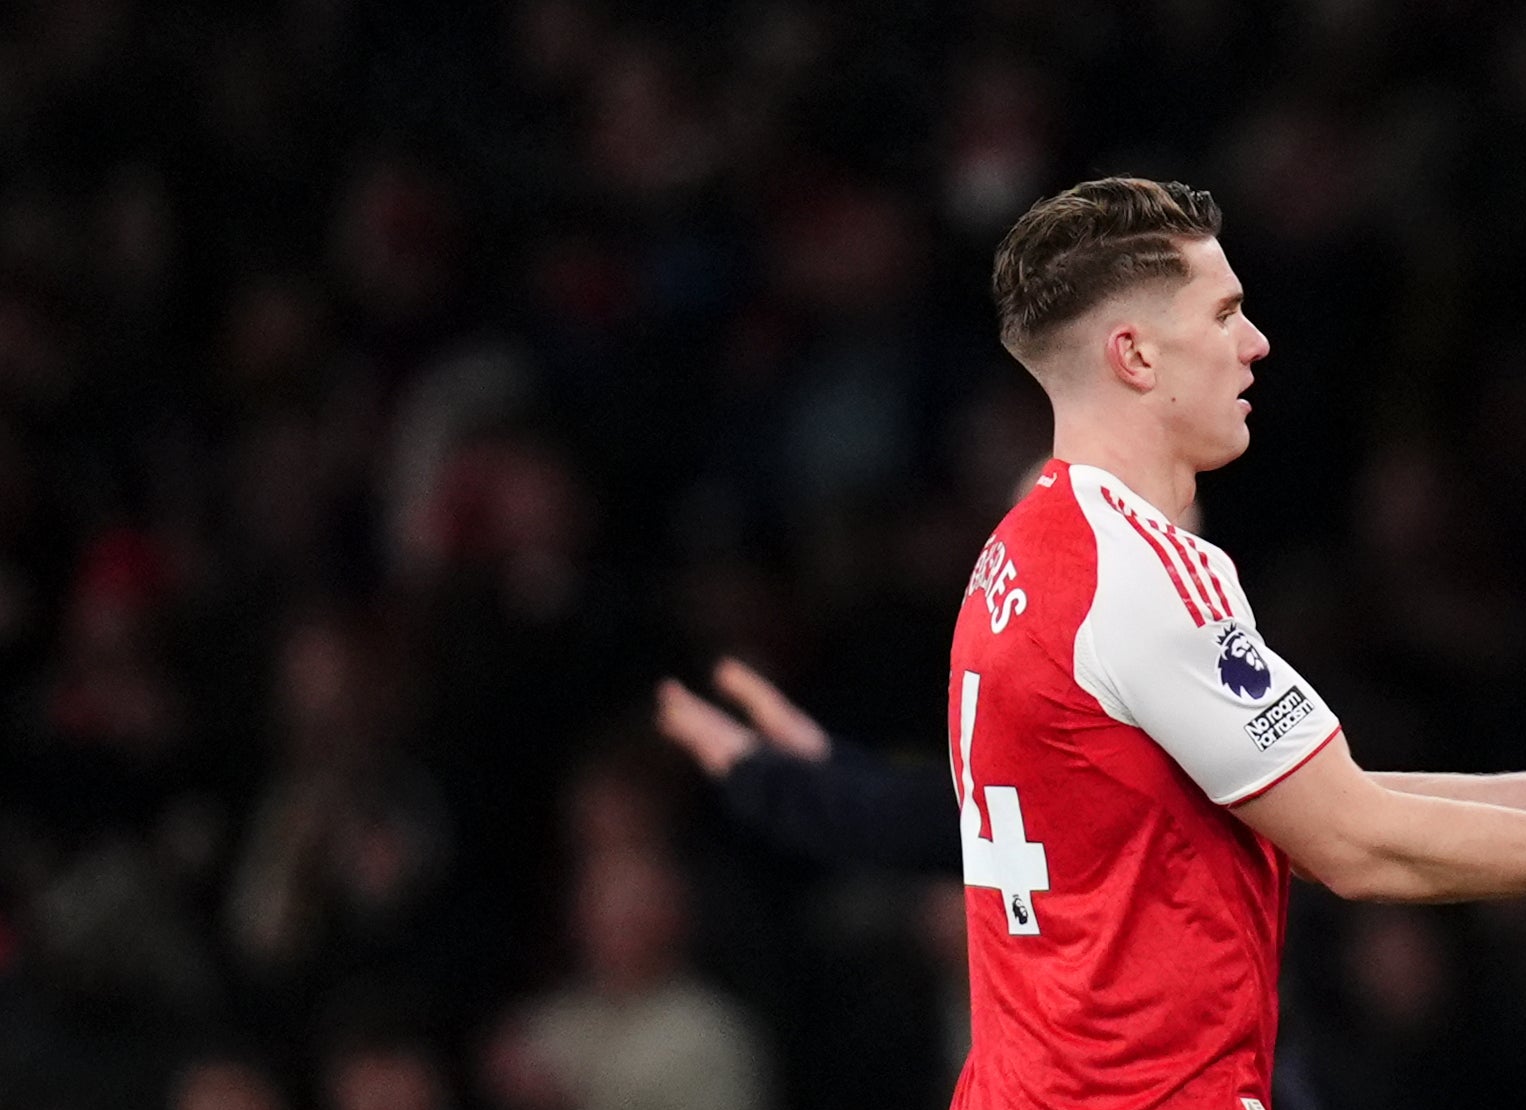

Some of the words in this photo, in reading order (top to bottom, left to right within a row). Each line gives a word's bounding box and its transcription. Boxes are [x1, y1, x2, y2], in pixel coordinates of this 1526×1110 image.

[1245, 717, 1270, 741] No
[1265, 691, 1303, 725] room
[1256, 727, 1278, 752] for
[1273, 698, 1315, 736] racism
[948, 669, 1050, 936] 4
